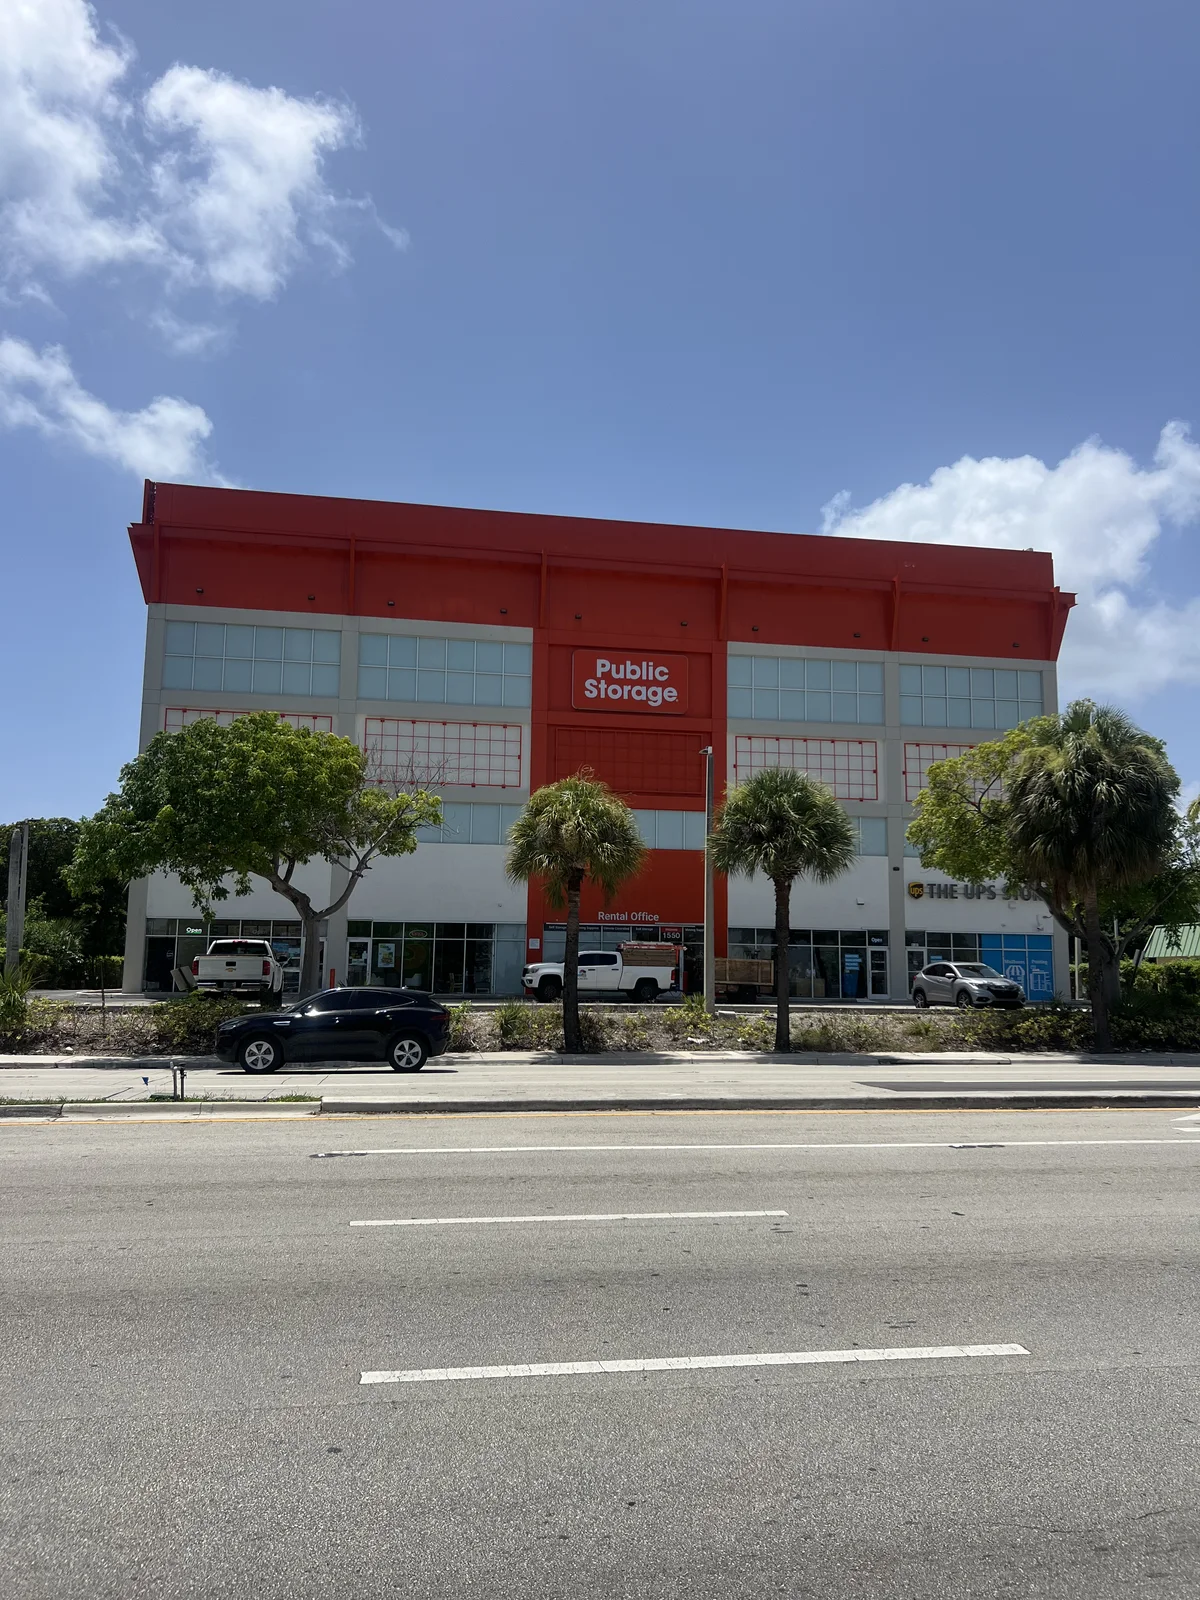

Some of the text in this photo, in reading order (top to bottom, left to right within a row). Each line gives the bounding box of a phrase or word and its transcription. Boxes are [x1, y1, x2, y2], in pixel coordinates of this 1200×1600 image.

[596, 659, 669, 681] Public
[584, 679, 678, 707] Storage
[910, 887, 924, 896] ups
[927, 883, 958, 899] THE
[963, 884, 996, 900] UPS
[598, 911, 660, 922] Rental Office
[186, 926, 202, 934] Open
